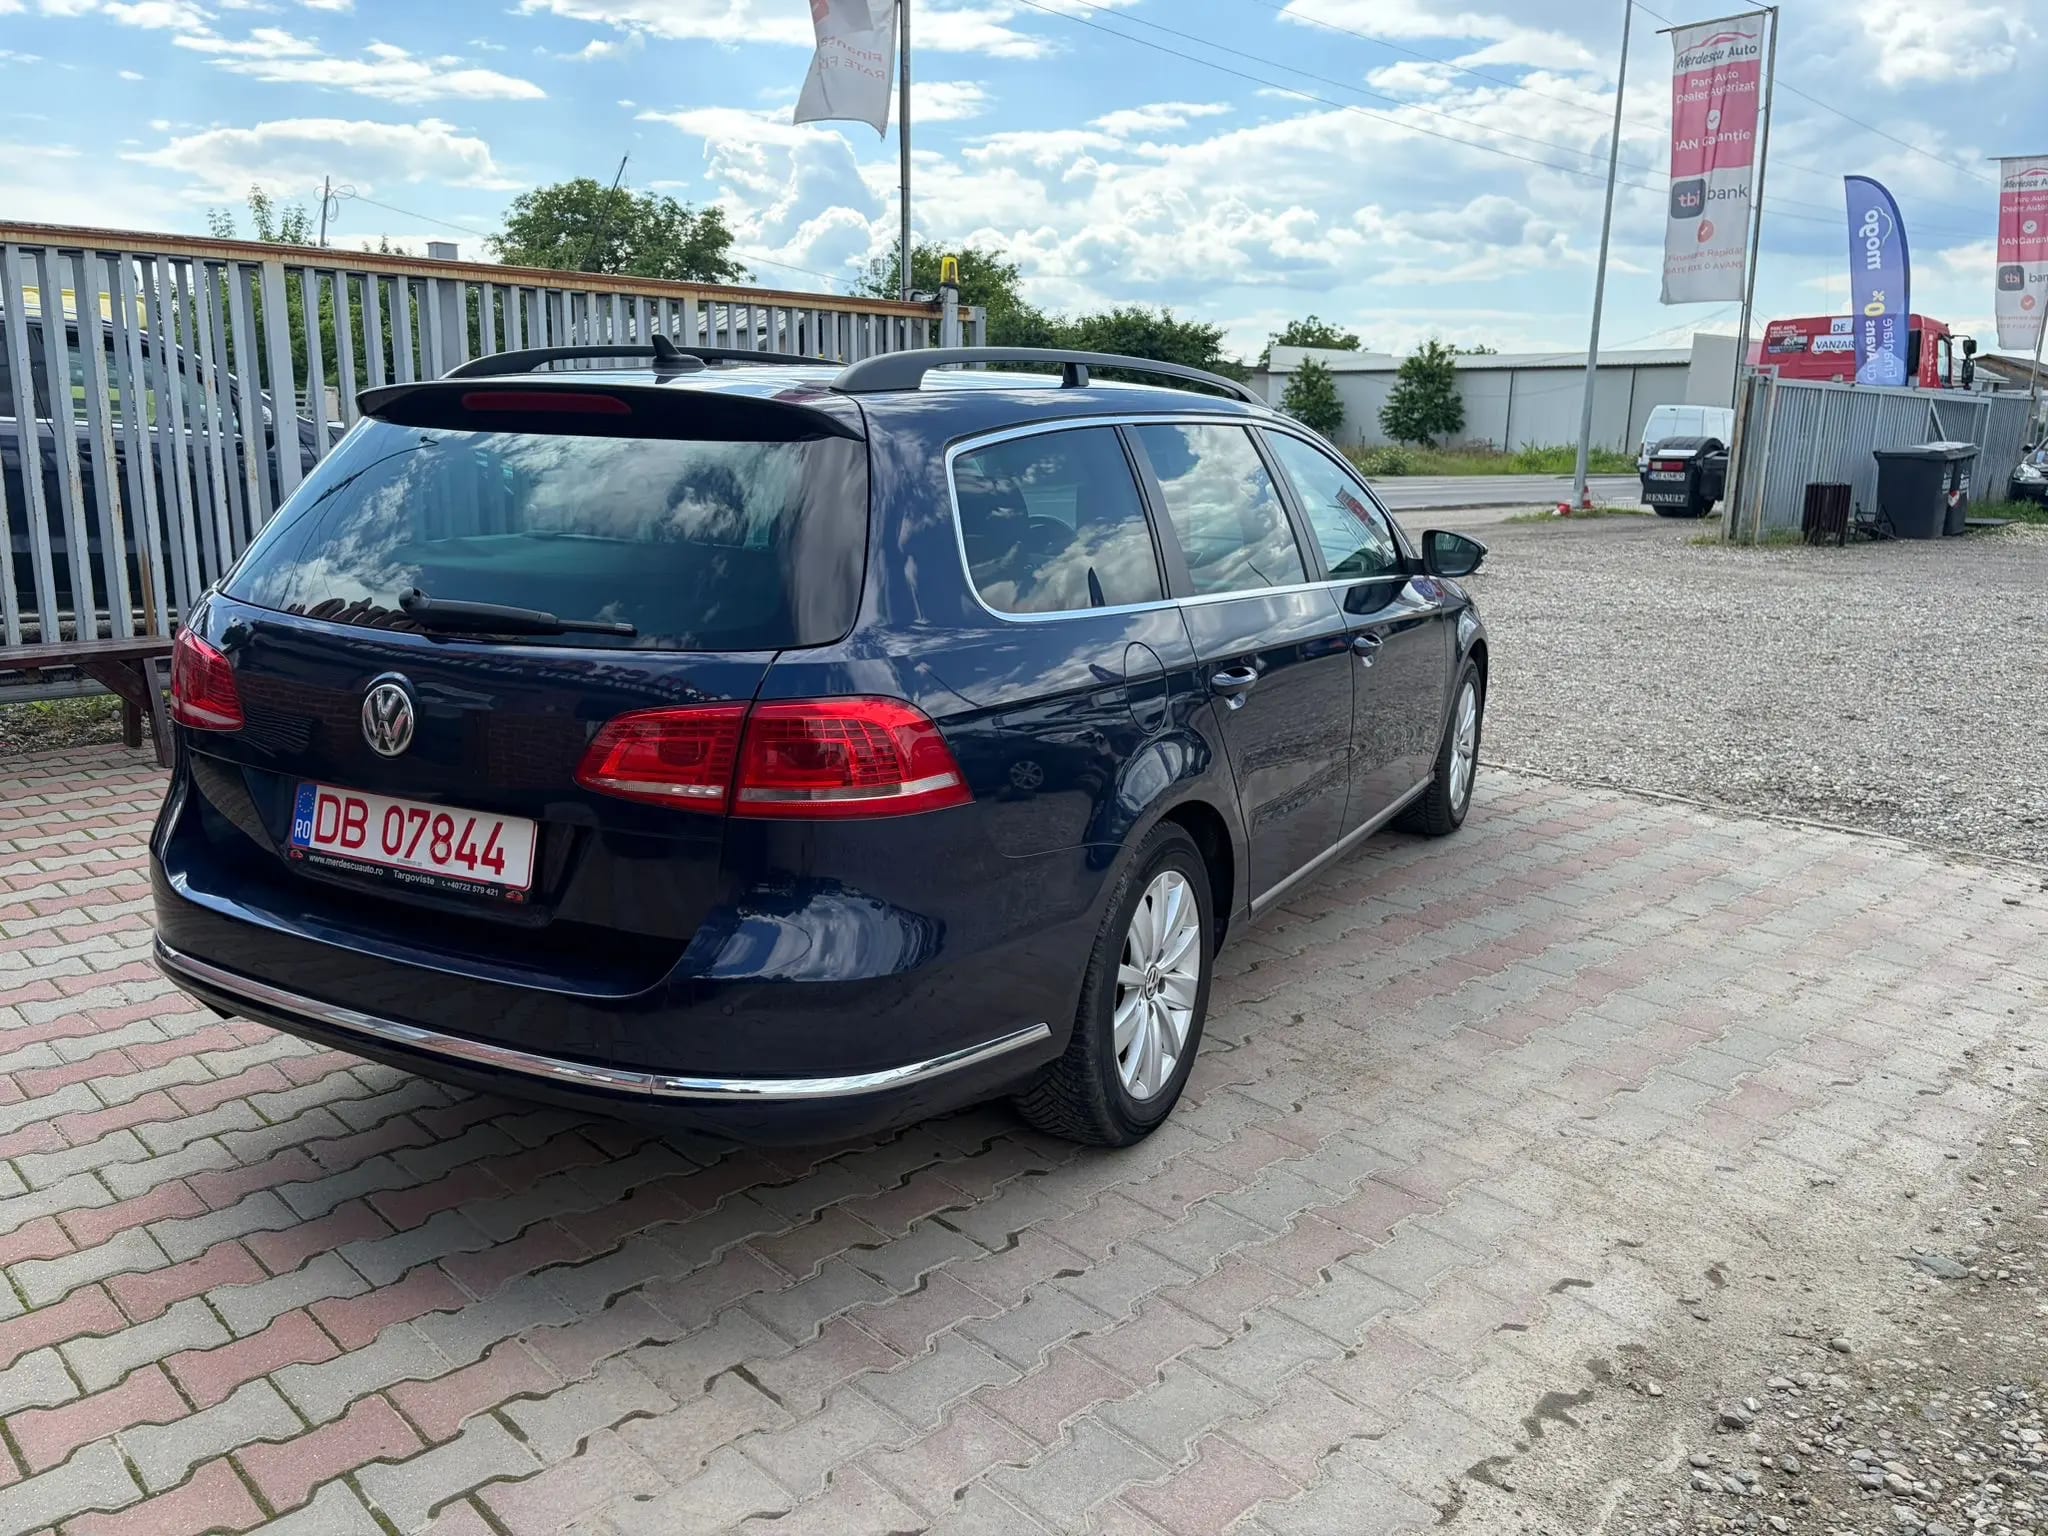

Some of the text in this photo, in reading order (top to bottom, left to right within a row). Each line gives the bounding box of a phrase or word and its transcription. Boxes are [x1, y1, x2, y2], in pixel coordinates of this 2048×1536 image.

[1728, 45, 1758, 58] Auto
[1678, 184, 1748, 207] tbi bank
[1833, 323, 1845, 332] DE
[1645, 493, 1686, 503] RENAULT
[294, 819, 312, 841] RO
[314, 792, 506, 876] DB 07844
[309, 854, 384, 876] www.merdescuauto.ro
[393, 869, 435, 886] Targoviste
[446, 881, 471, 892] +40722
[472, 885, 485, 895] 579
[486, 887, 499, 897] 421
